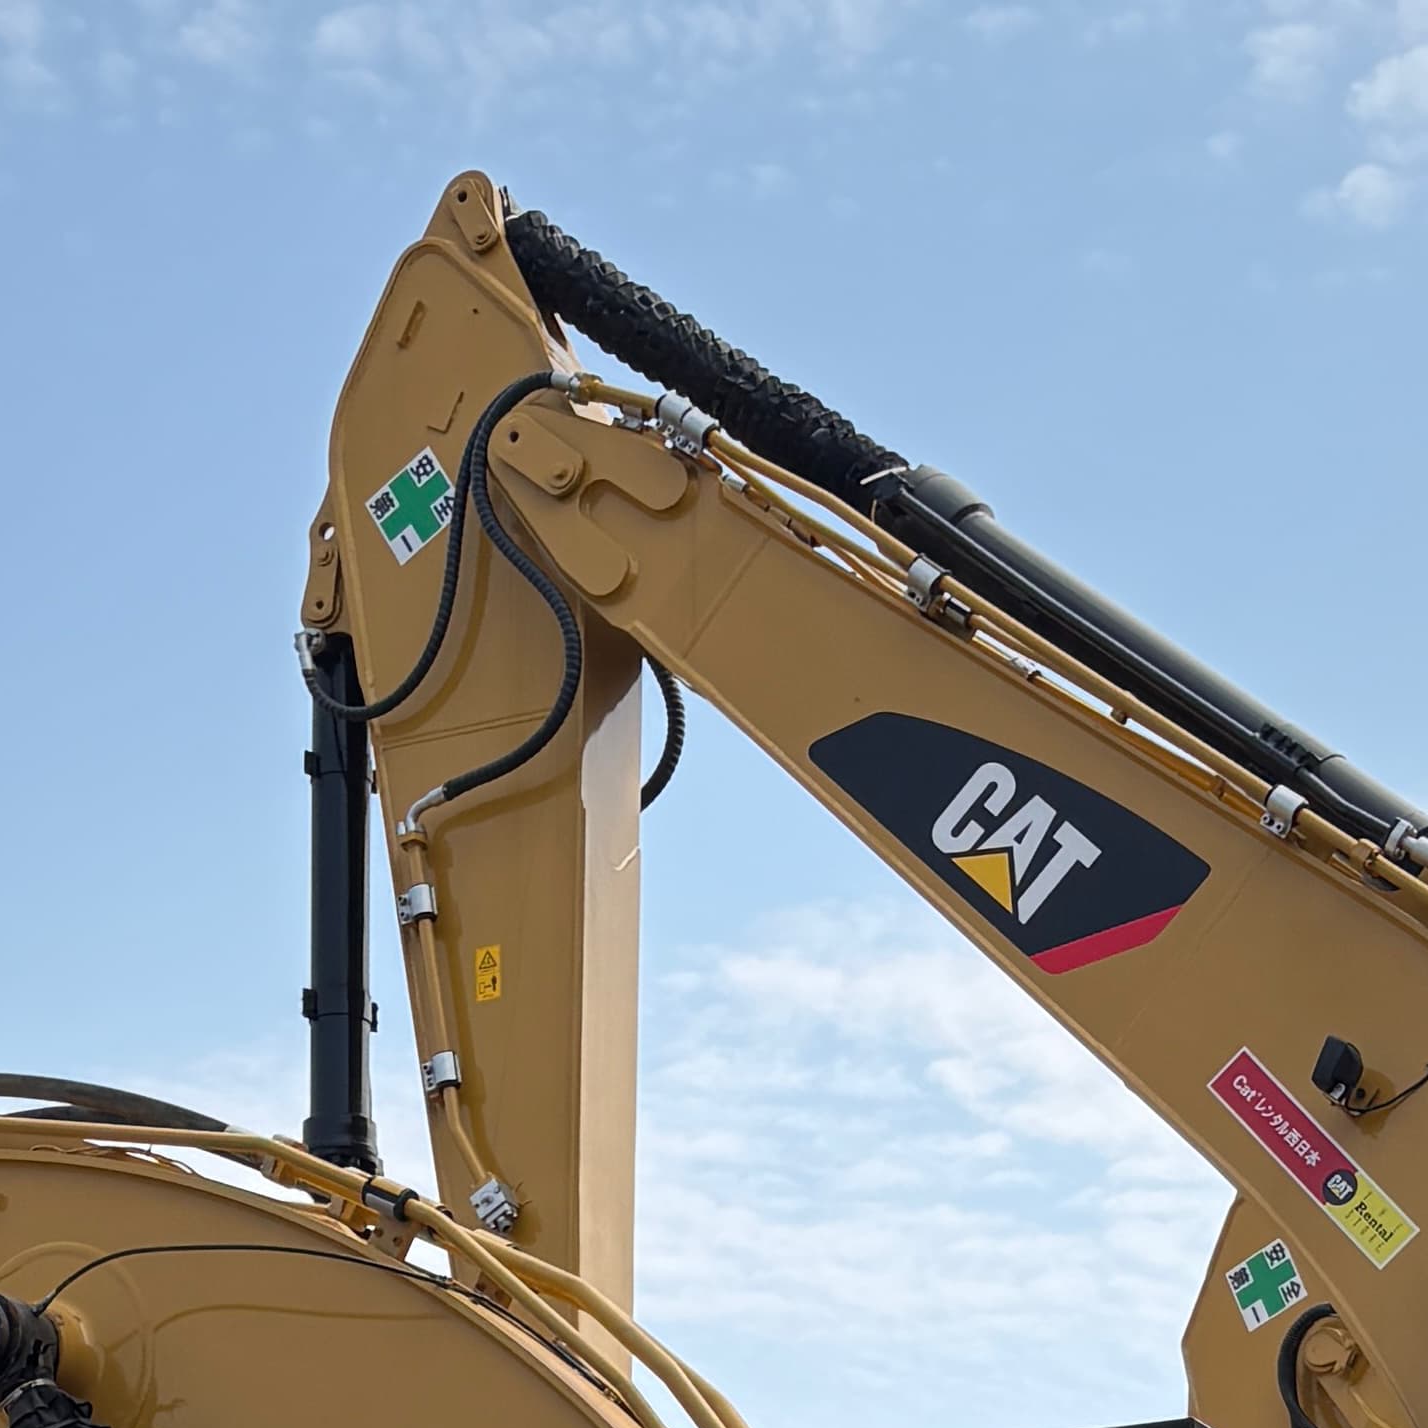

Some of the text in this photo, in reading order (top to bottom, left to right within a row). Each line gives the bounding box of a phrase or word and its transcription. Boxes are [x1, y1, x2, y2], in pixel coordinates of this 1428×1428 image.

[932, 762, 1102, 925] CAT
[1327, 1174, 1353, 1200] CAT
[1354, 1200, 1394, 1243] Rental
